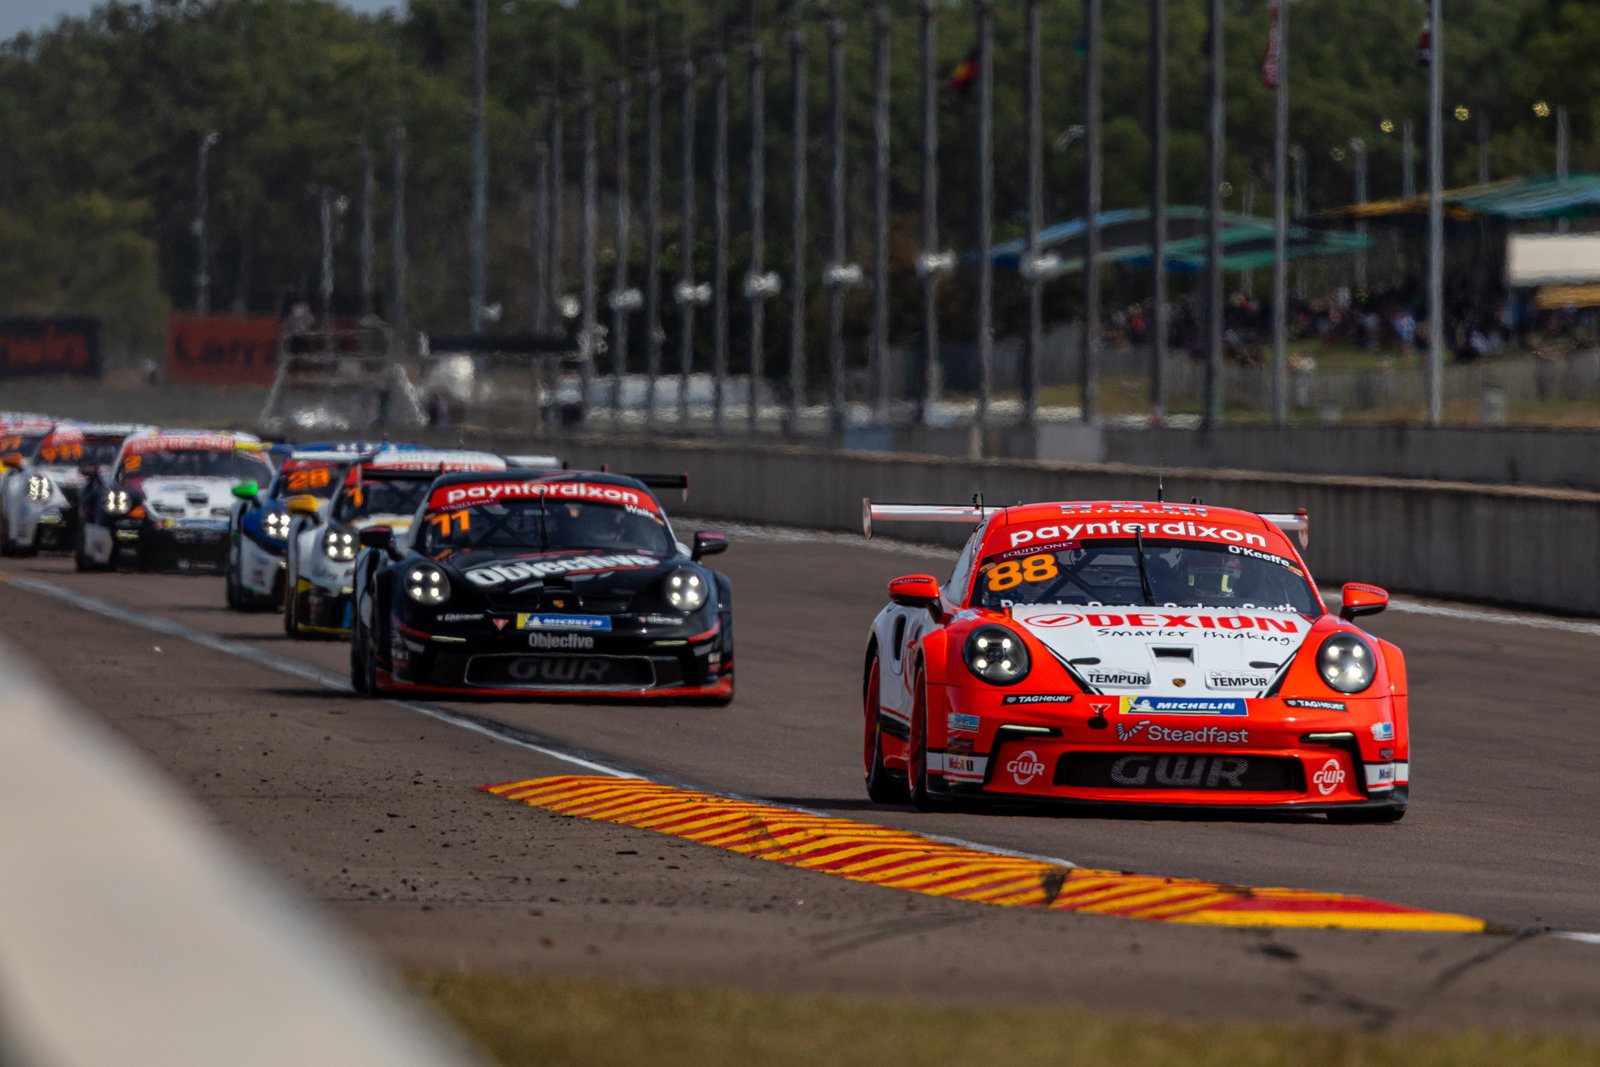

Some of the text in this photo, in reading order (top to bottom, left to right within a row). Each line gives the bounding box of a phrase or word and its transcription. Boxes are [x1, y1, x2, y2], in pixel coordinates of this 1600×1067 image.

[447, 482, 638, 503] paynterdixon
[432, 510, 470, 537] 11
[1010, 520, 1266, 548] paynterdixon
[1228, 545, 1290, 567] O'Keeffe
[987, 553, 1059, 592] 88
[1085, 614, 1299, 633] DEXION
[528, 632, 595, 649] Objective
[508, 656, 612, 681] GWR
[1088, 673, 1147, 686] TEMPUR
[1211, 677, 1268, 688] TEMPUR
[1156, 702, 1236, 710] MICHELIN
[1147, 725, 1249, 743] Steadfast
[1006, 760, 1046, 776] GWR
[1110, 754, 1249, 788] GWR
[1312, 769, 1346, 784] GWR
